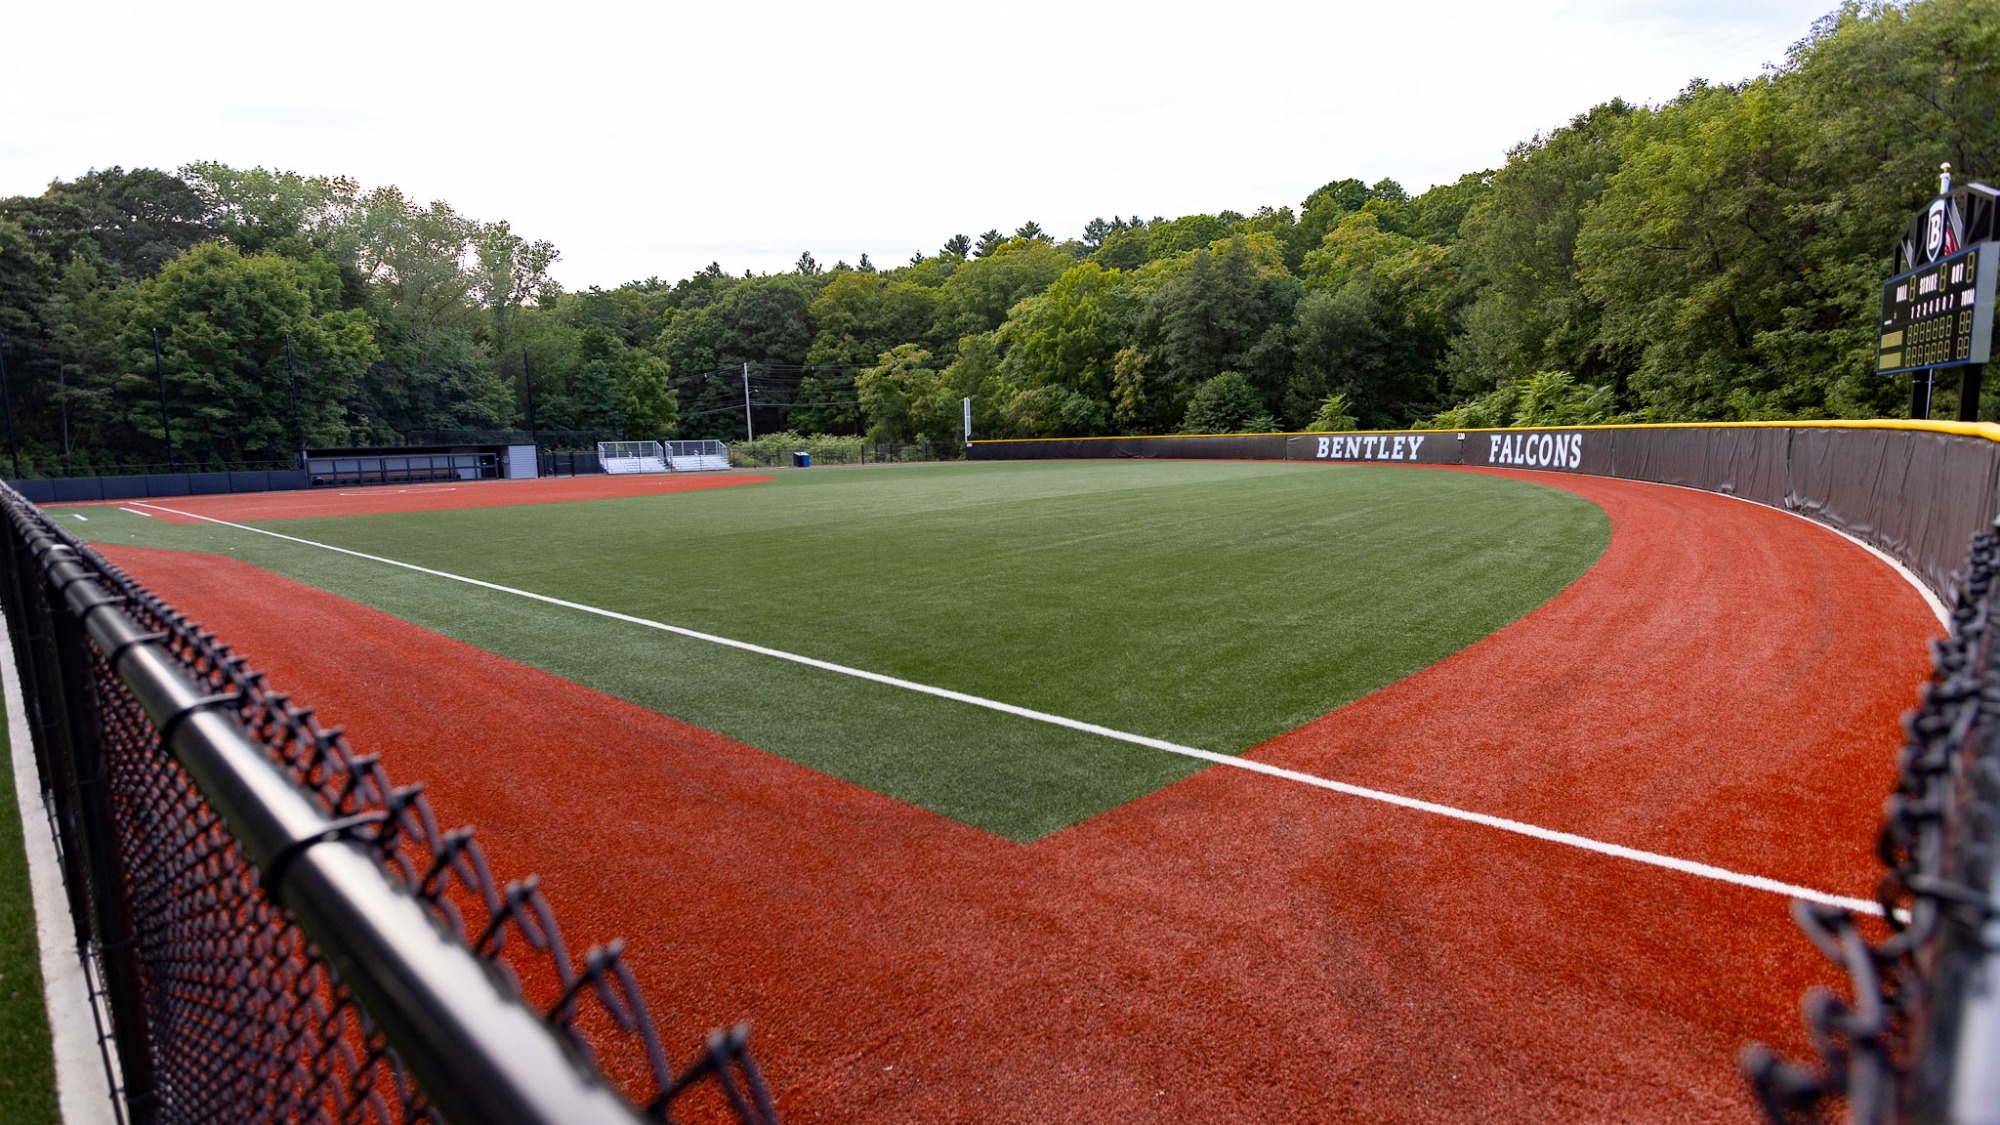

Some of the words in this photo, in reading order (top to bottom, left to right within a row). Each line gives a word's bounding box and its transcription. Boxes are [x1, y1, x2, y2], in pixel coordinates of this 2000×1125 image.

[1929, 214, 1940, 250] B
[1919, 273, 1938, 295] STRIKE
[1316, 436, 1424, 460] BENTLEY
[1489, 433, 1582, 469] FALCONS
